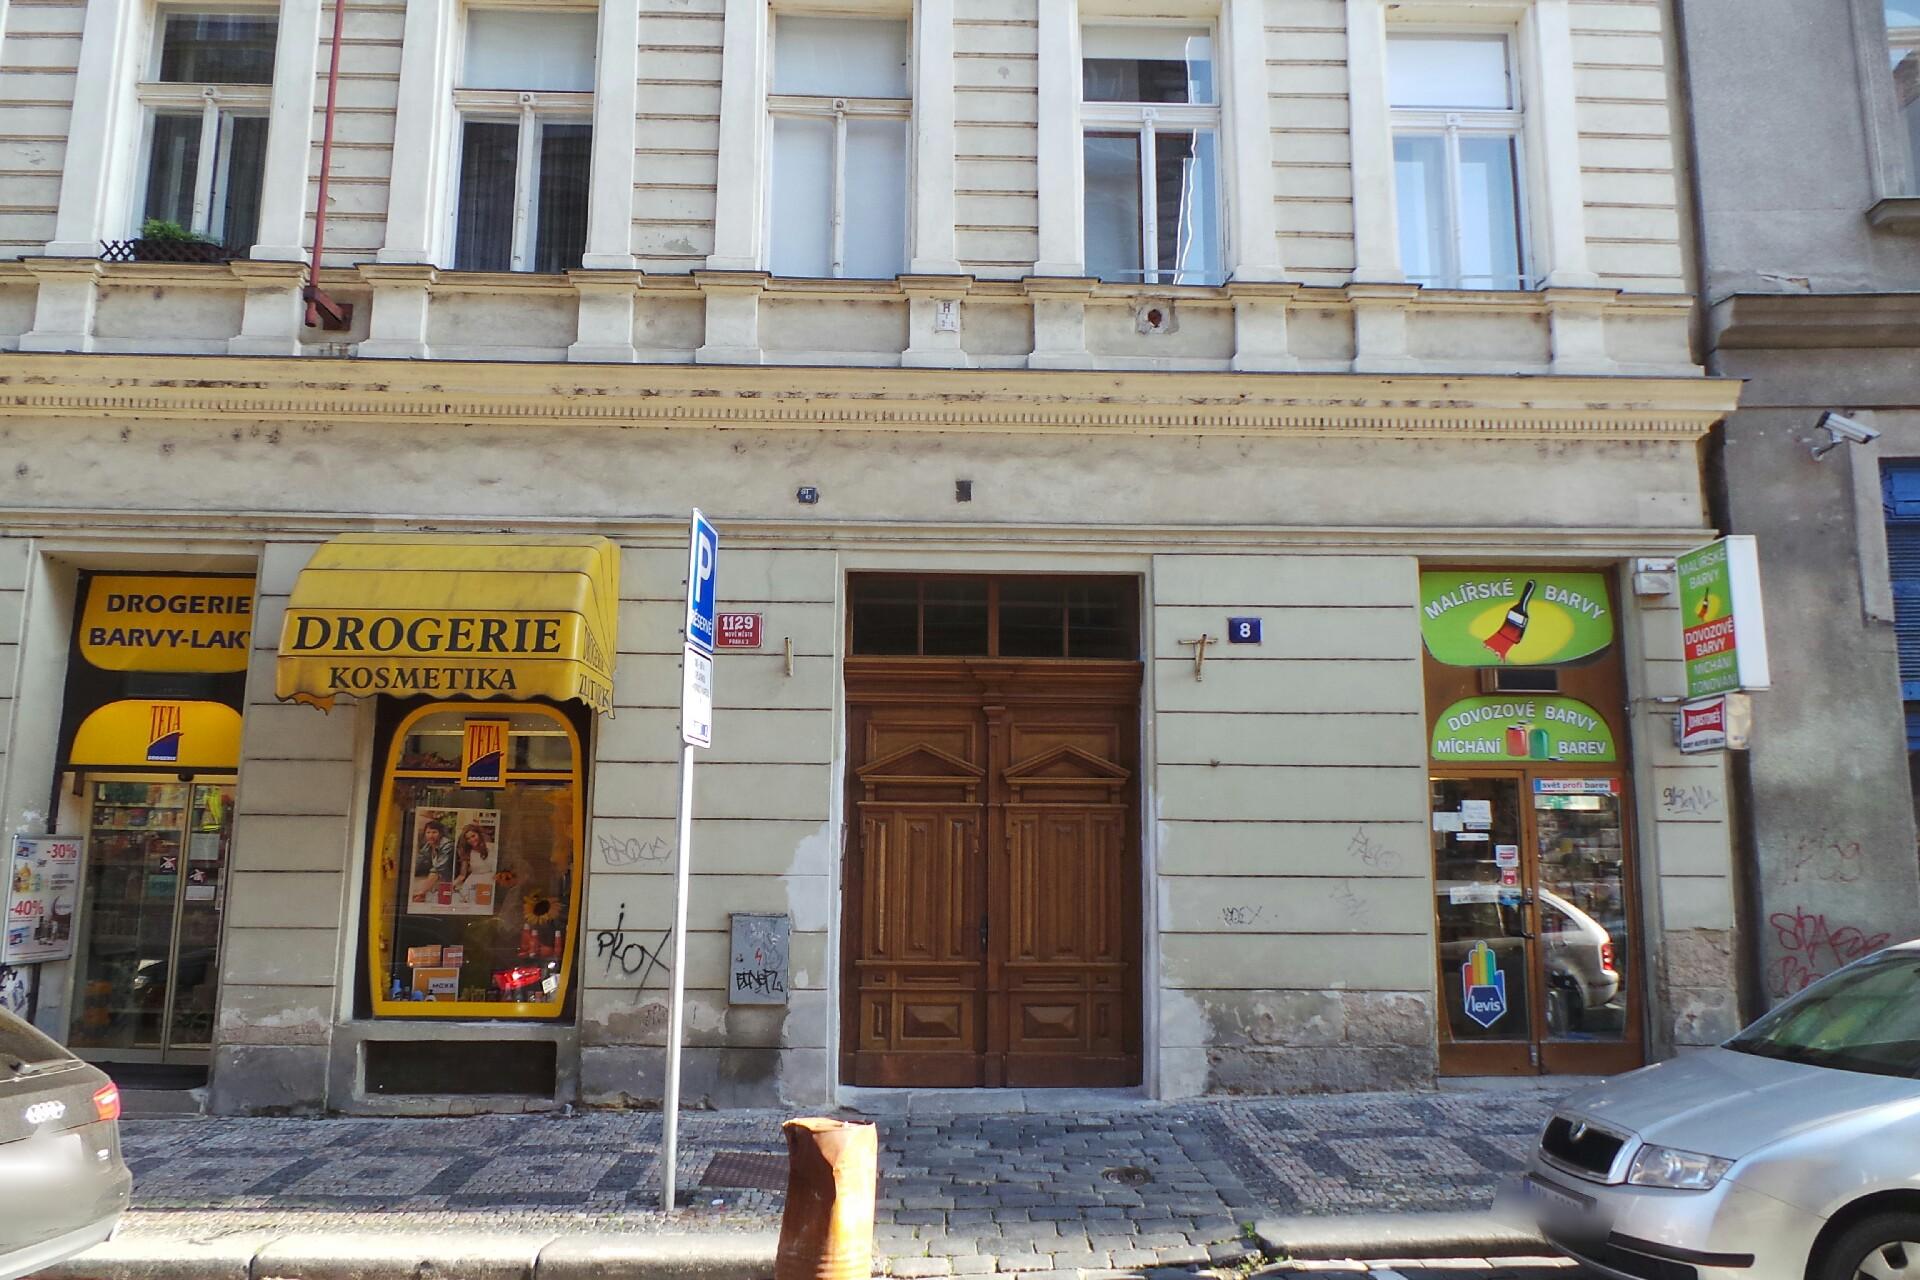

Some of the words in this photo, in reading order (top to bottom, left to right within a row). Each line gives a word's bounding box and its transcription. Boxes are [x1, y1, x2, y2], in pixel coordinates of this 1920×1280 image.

[696, 531, 712, 603] P
[1689, 569, 1720, 589] BARVY
[107, 594, 251, 614] DROGERIE
[1424, 578, 1516, 620] MALÍŘSKÉ
[1544, 585, 1606, 620] BARVY
[722, 616, 754, 631] 1129
[1239, 622, 1251, 638] 8
[1685, 616, 1735, 646] DOVOZOVÉ
[89, 627, 251, 649] BARVY-LAK
[295, 615, 562, 655] DROGERIE
[724, 630, 737, 638] NOVÉ
[1695, 637, 1726, 657] BARVY
[328, 665, 518, 691] KOSMETIKA
[150, 705, 184, 743] TETA
[1447, 701, 1536, 732] DOVOZOVÉ
[1544, 705, 1598, 732] BARVY
[469, 725, 504, 763] TETA
[1437, 737, 1502, 754] MÍCHÁNÍ
[1557, 741, 1607, 754] BAREV
[1562, 781, 1583, 790] profi
[1584, 781, 1609, 789] barev
[47, 843, 77, 859] -30%
[10, 900, 44, 916] -40%
[1471, 996, 1501, 1013] levis
